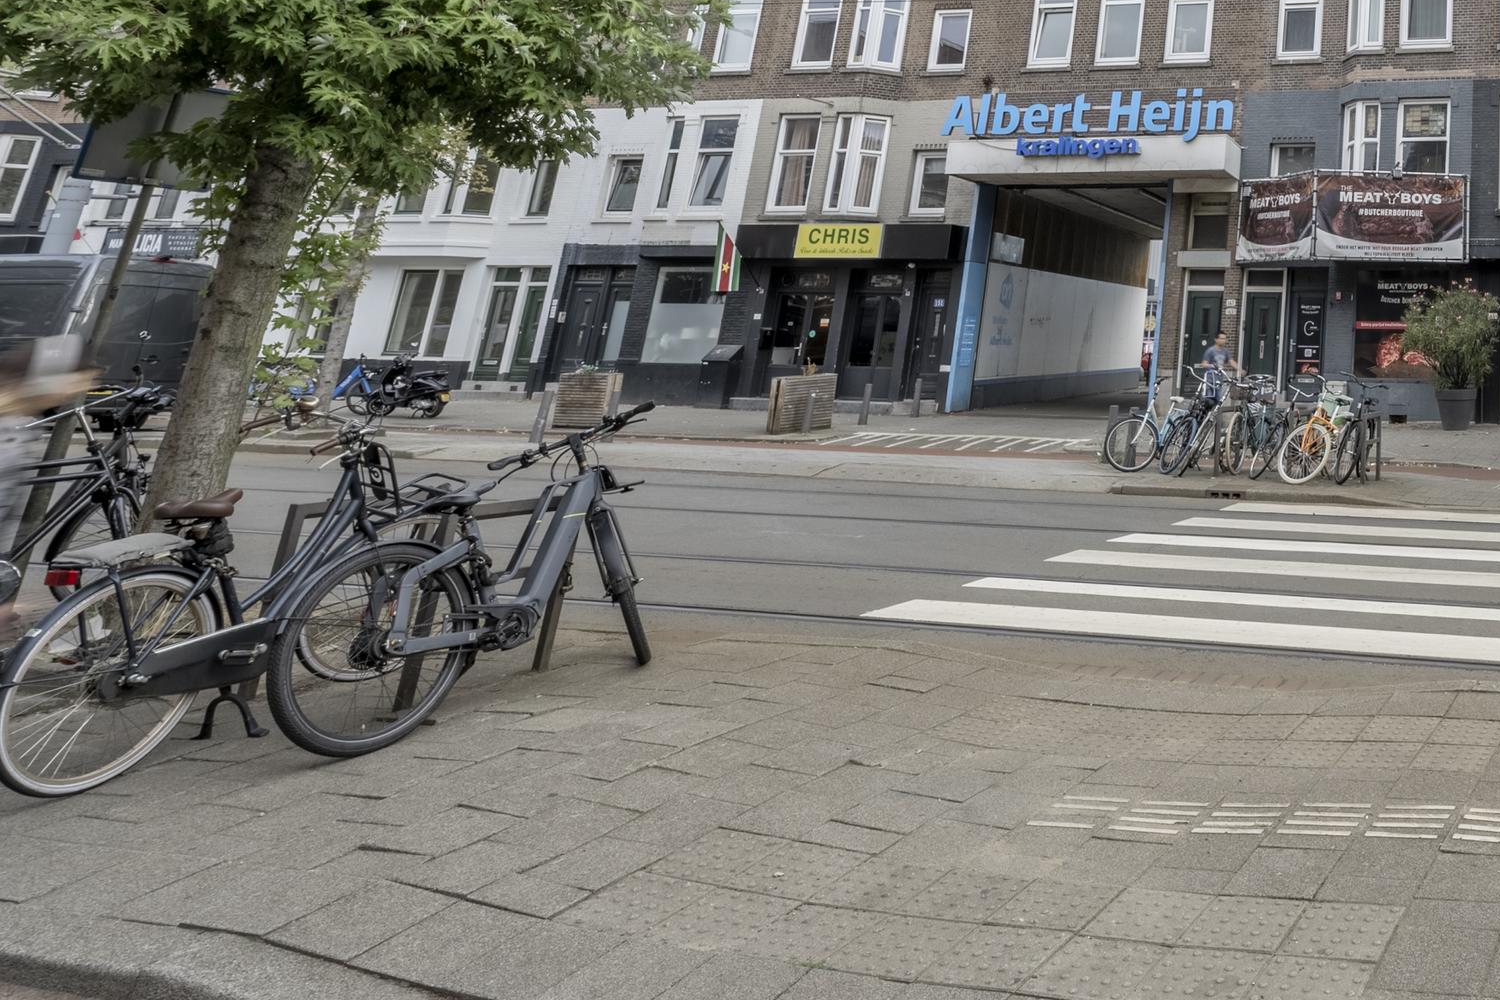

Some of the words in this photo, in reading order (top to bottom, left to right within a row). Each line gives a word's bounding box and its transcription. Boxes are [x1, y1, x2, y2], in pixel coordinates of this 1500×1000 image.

[940, 92, 1092, 136] Albert
[1107, 88, 1235, 142] Heijn
[1016, 136, 1140, 159] kralingen
[1250, 196, 1271, 209] MEAT
[1278, 193, 1301, 206] BOYS
[1339, 191, 1383, 203] MEAT
[1401, 193, 1442, 204] BOYS
[1358, 208, 1424, 217] #BUTCHERBOUTIQUE
[808, 228, 870, 244] CHRIS
